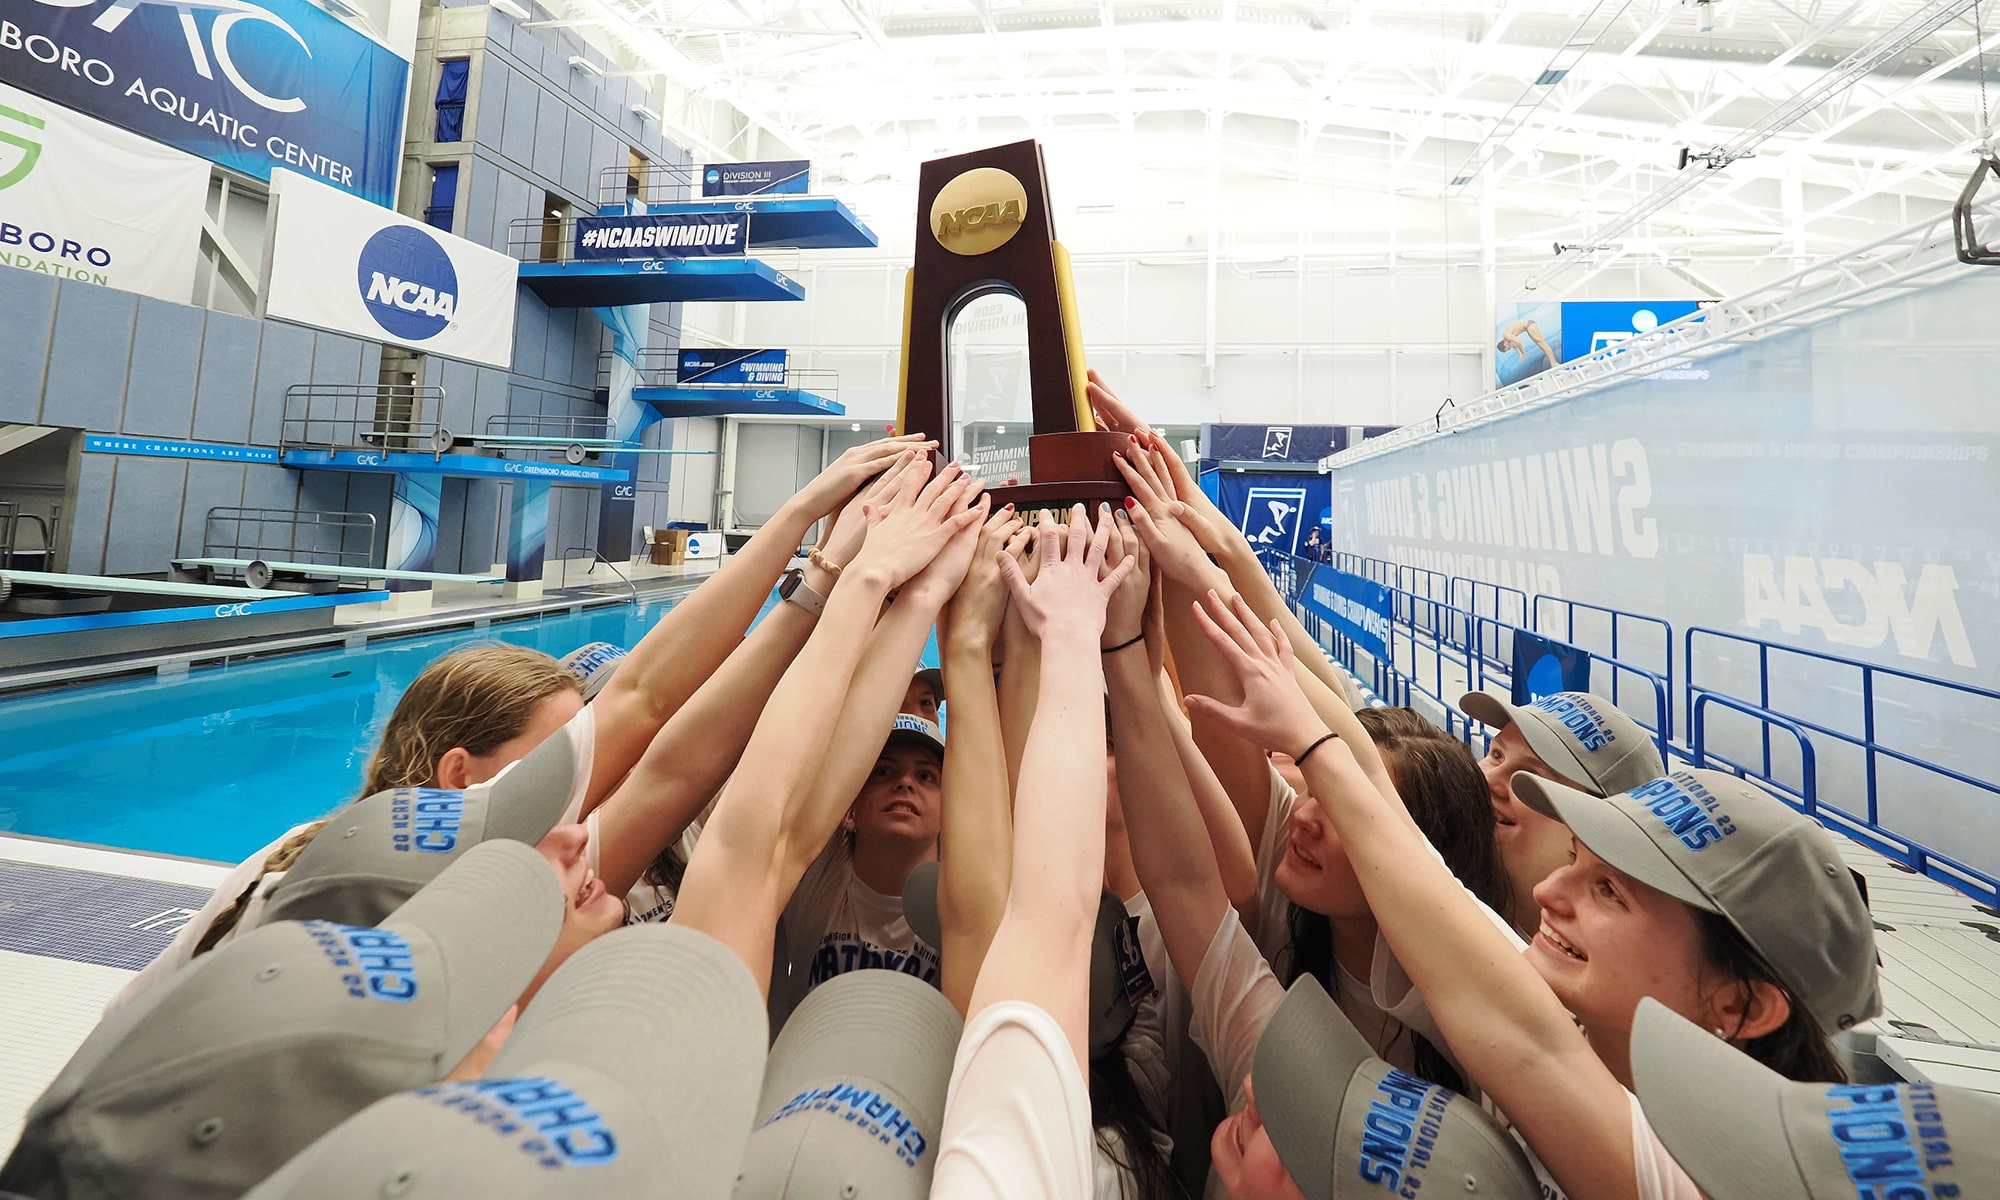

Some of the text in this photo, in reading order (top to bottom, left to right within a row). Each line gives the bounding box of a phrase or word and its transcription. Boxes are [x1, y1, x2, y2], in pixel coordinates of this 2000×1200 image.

[124, 76, 259, 149] AQUATIC
[265, 136, 354, 187] CENTER
[723, 171, 762, 180] DIVISION
[763, 170, 772, 179] III
[734, 201, 754, 211] GAC
[937, 199, 1024, 237] NCAA
[581, 223, 739, 249] #NCAASWIMDIVE
[642, 261, 665, 272] GAC
[366, 271, 455, 321] NCAA
[954, 311, 1026, 337] DIVISION III
[739, 362, 784, 373] SWIMMING
[747, 372, 784, 383] & DIVING
[755, 389, 776, 399] GAC
[92, 440, 274, 460] WHERE CHAMPIONS ARE MADE
[356, 454, 379, 467] GAC
[504, 462, 523, 474] GAC
[981, 459, 1018, 475] DIVING
[614, 484, 633, 497] GAC
[214, 602, 252, 619] GAC
[1603, 728, 1616, 742] 23
[1715, 814, 1737, 836] 23
[1400, 1174, 1422, 1200] 23
